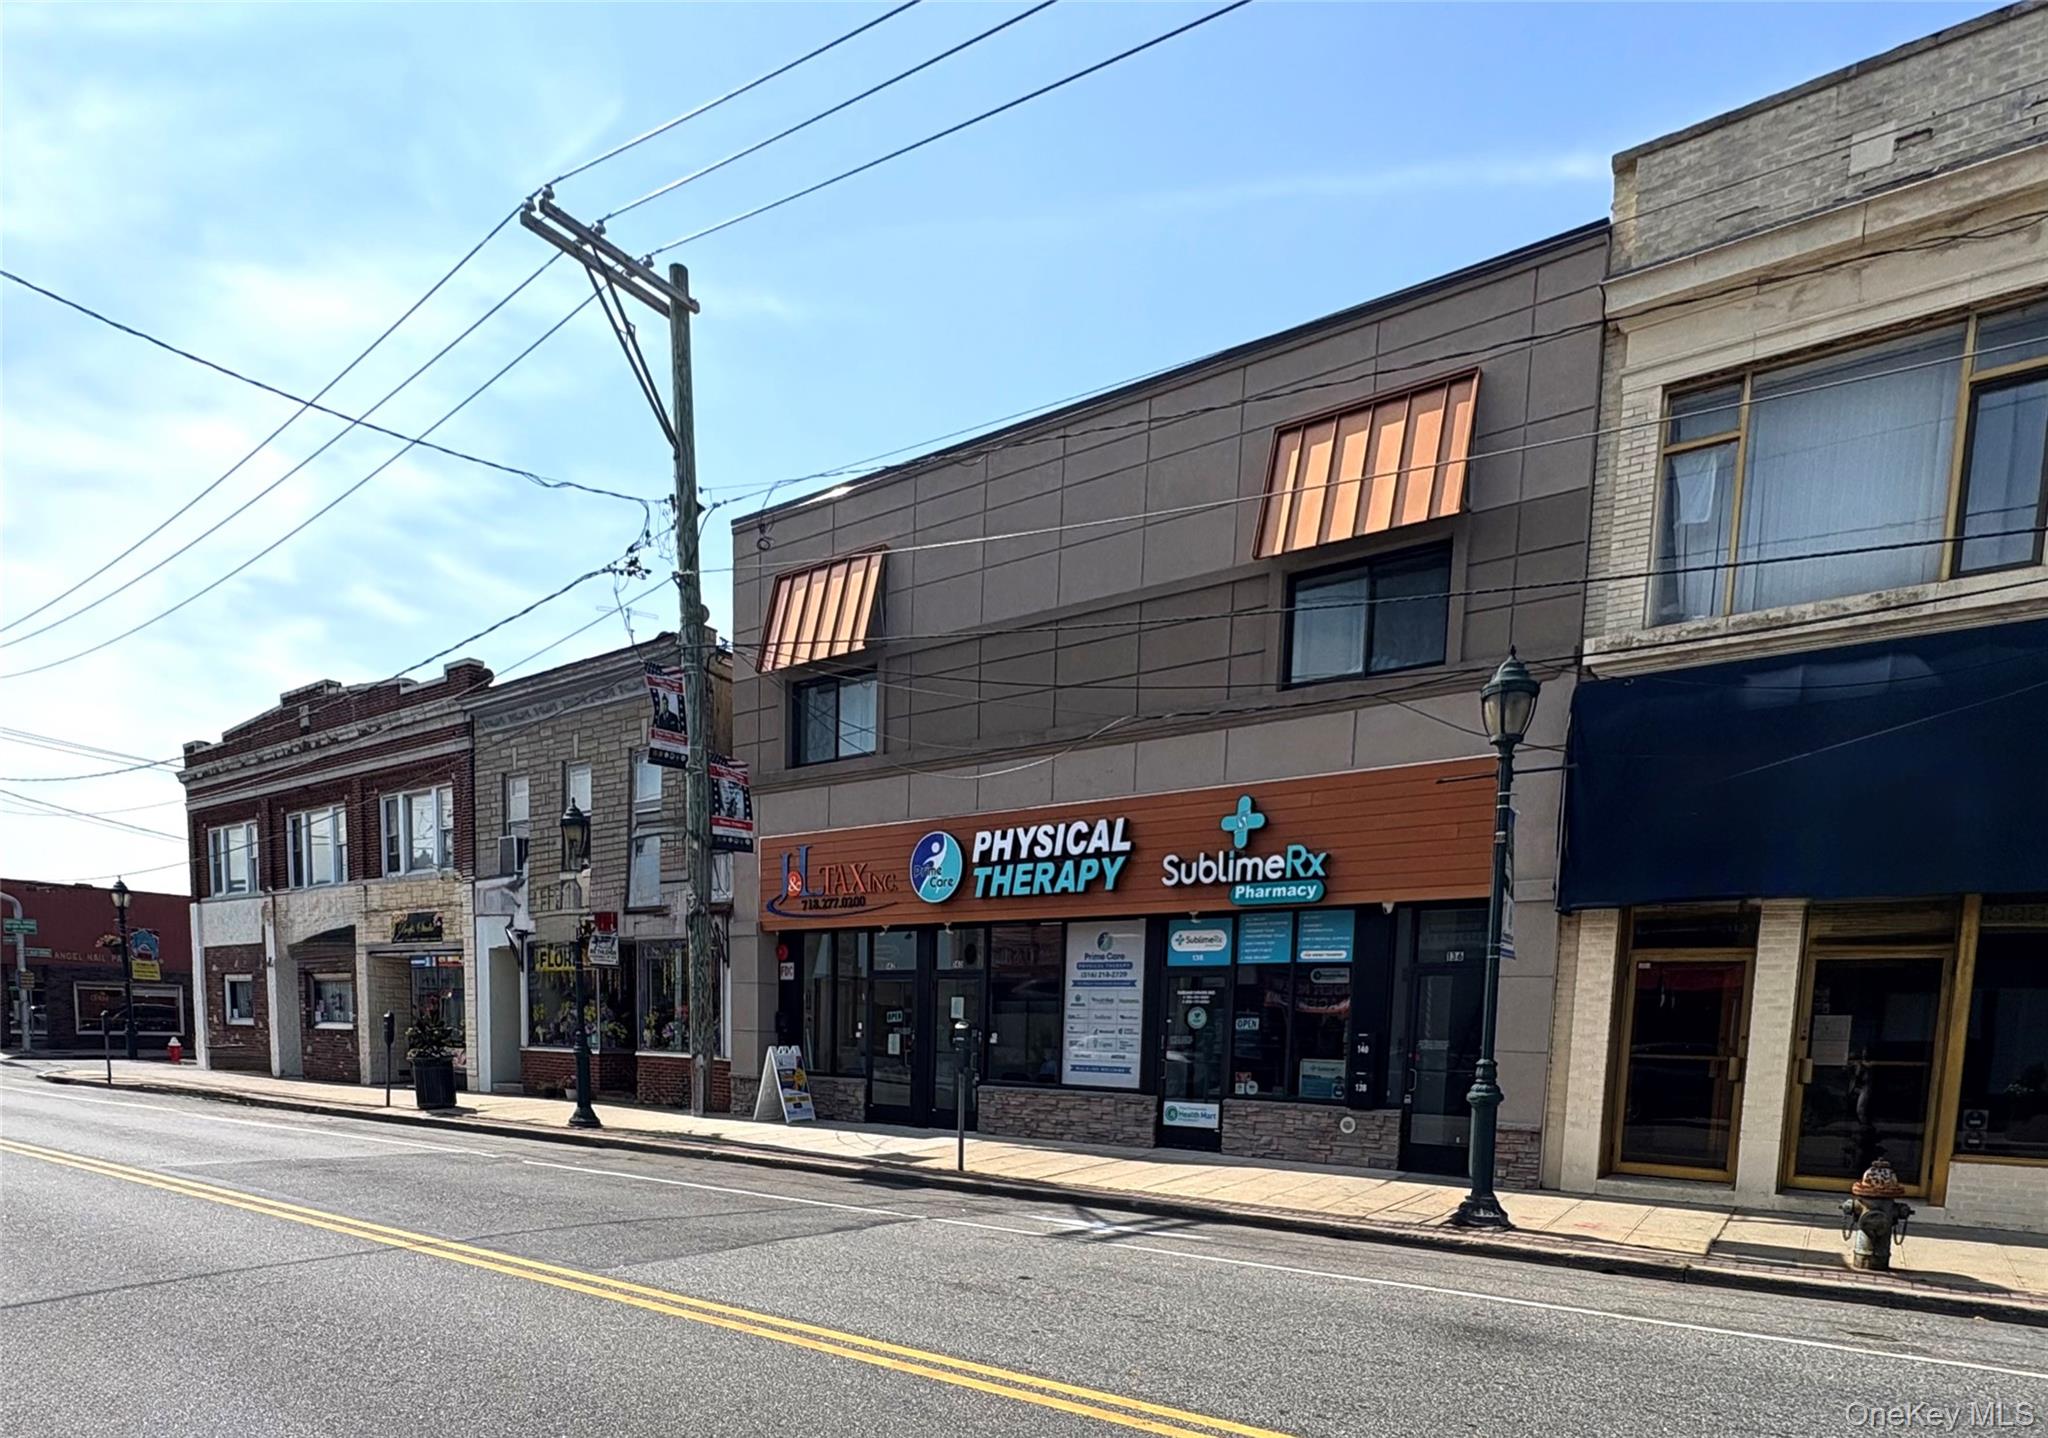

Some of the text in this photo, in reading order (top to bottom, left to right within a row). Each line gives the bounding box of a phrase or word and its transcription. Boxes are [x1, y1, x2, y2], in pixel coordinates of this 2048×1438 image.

[972, 817, 1131, 863] PHYSICAL
[818, 863, 868, 896] TAX
[972, 856, 1127, 898] THERAPY
[1161, 844, 1327, 886] SublimeRx
[1234, 884, 1317, 899] Pharmacy
[540, 949, 576, 968] FLOR
[1237, 1019, 1257, 1028] OPEN
